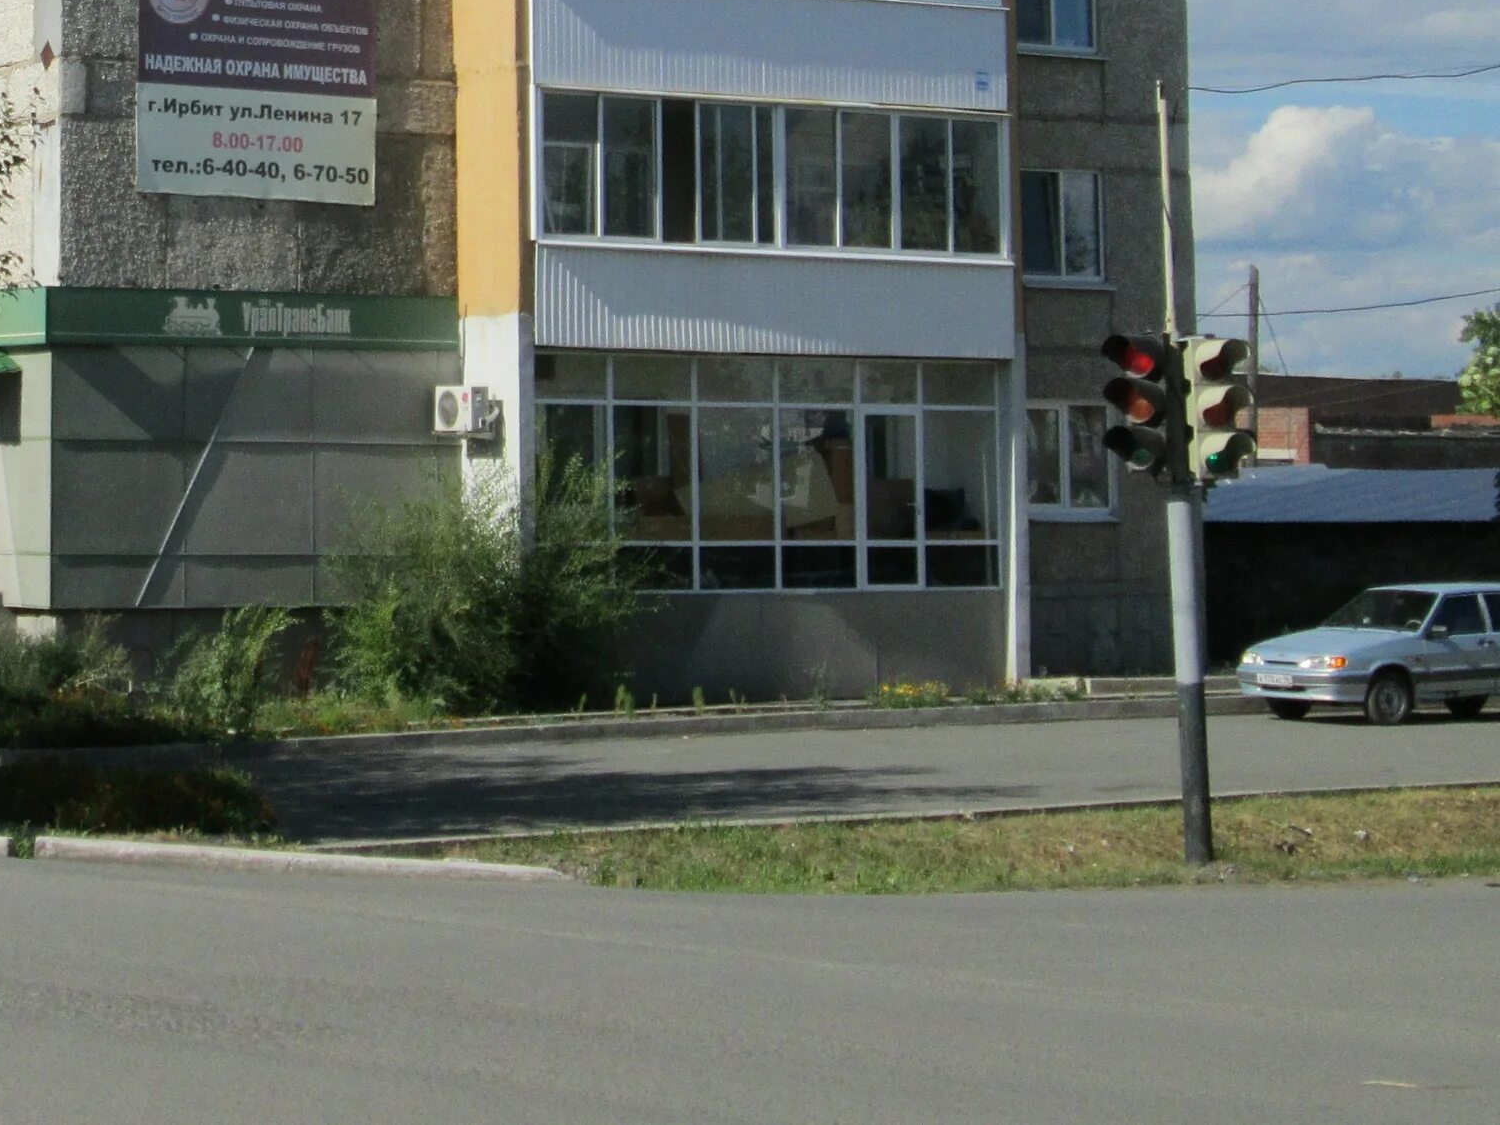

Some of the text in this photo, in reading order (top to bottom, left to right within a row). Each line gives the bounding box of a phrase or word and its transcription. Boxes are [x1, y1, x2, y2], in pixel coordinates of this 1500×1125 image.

[288, 2, 323, 14] ОХРАНА
[222, 15, 368, 36] ФИЗИЧЕСКАЯ ОХРАНА ОБЪЕКТОВ
[201, 33, 236, 45] ОХРАНА
[239, 35, 244, 44] И
[327, 43, 361, 54] ГРУЗОВ
[145, 53, 368, 86] НАДЕЖНАЯ ОХРАНА ИМУЩЕСТВА
[148, 98, 362, 126] г.Ирбит ул.Ленина 17
[212, 131, 304, 153] 8.00-17.00
[293, 163, 369, 185] 6-70-50
